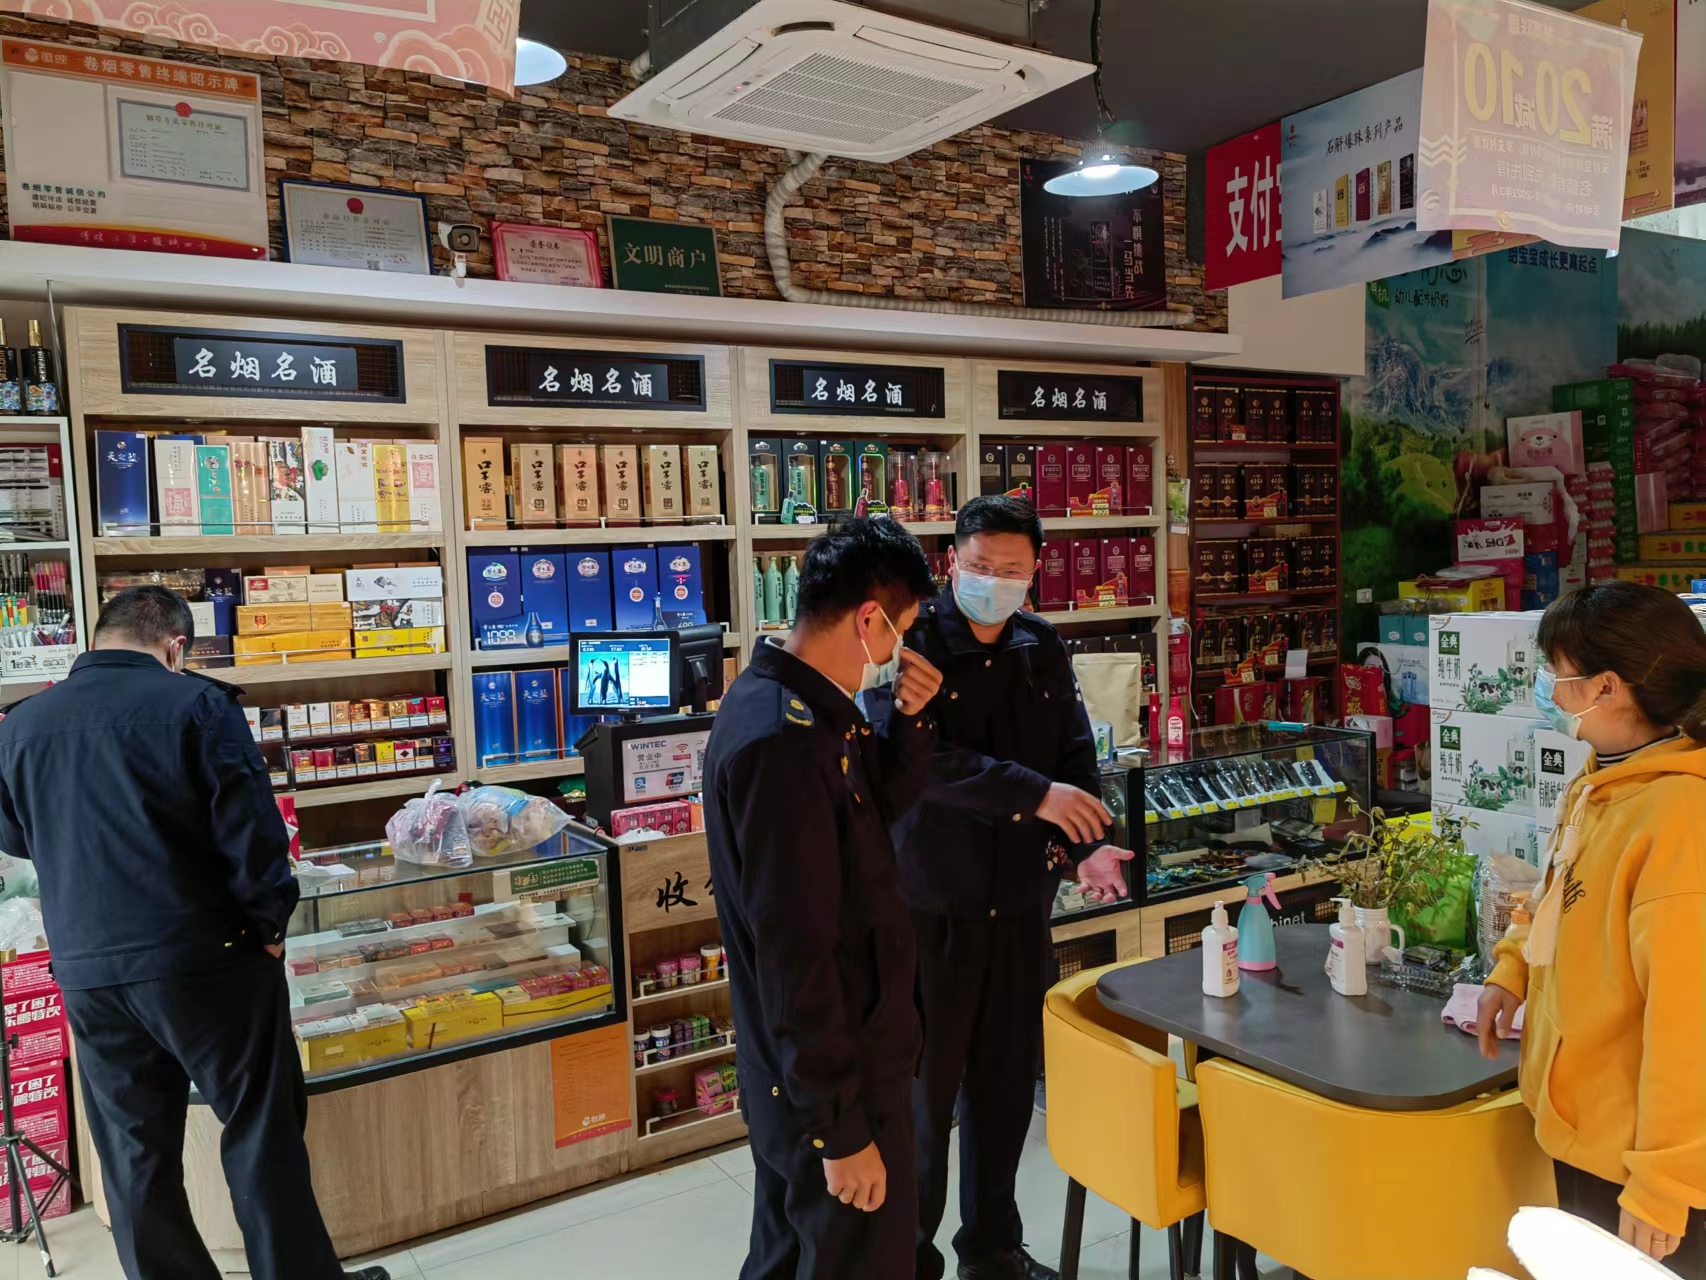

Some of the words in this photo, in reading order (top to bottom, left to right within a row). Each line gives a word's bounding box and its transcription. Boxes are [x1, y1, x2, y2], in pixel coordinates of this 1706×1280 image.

[83, 55, 239, 91] 卷烟零售终端昭示牌
[1326, 116, 1403, 156] 石斛爆珠系列产品
[22, 182, 106, 199] 卷烟零售诚信公约
[66, 204, 97, 215] 公平交易
[1226, 155, 1282, 258] 支付
[623, 242, 706, 269] 文明商户
[1123, 239, 1135, 299] 一马当先
[187, 349, 338, 387] 名烟名酒
[538, 365, 654, 398] 名烟名酒
[811, 376, 902, 406] 名烟名酒
[1031, 386, 1107, 411] 名烟名酒
[478, 460, 493, 494] 口子窖
[531, 460, 545, 492] 口子窖
[574, 460, 588, 492] 口子窖
[615, 460, 629, 492] 口子窖
[660, 460, 674, 491] 口子窖
[697, 460, 711, 491] 口子窖
[1440, 634, 1459, 648] 金典
[1438, 656, 1461, 681] 纯牛奶
[631, 741, 667, 750] WINTEC
[1442, 729, 1460, 744] 金典
[637, 752, 662, 762] 营业中
[1440, 752, 1462, 776] 纯牛奶
[1542, 751, 1564, 769] 金典
[4, 994, 59, 1016] 累了困了
[5, 1006, 61, 1028] 东鹏特饮
[11, 1074, 56, 1095] 了困了
[13, 1086, 59, 1106] 鹏特饮
